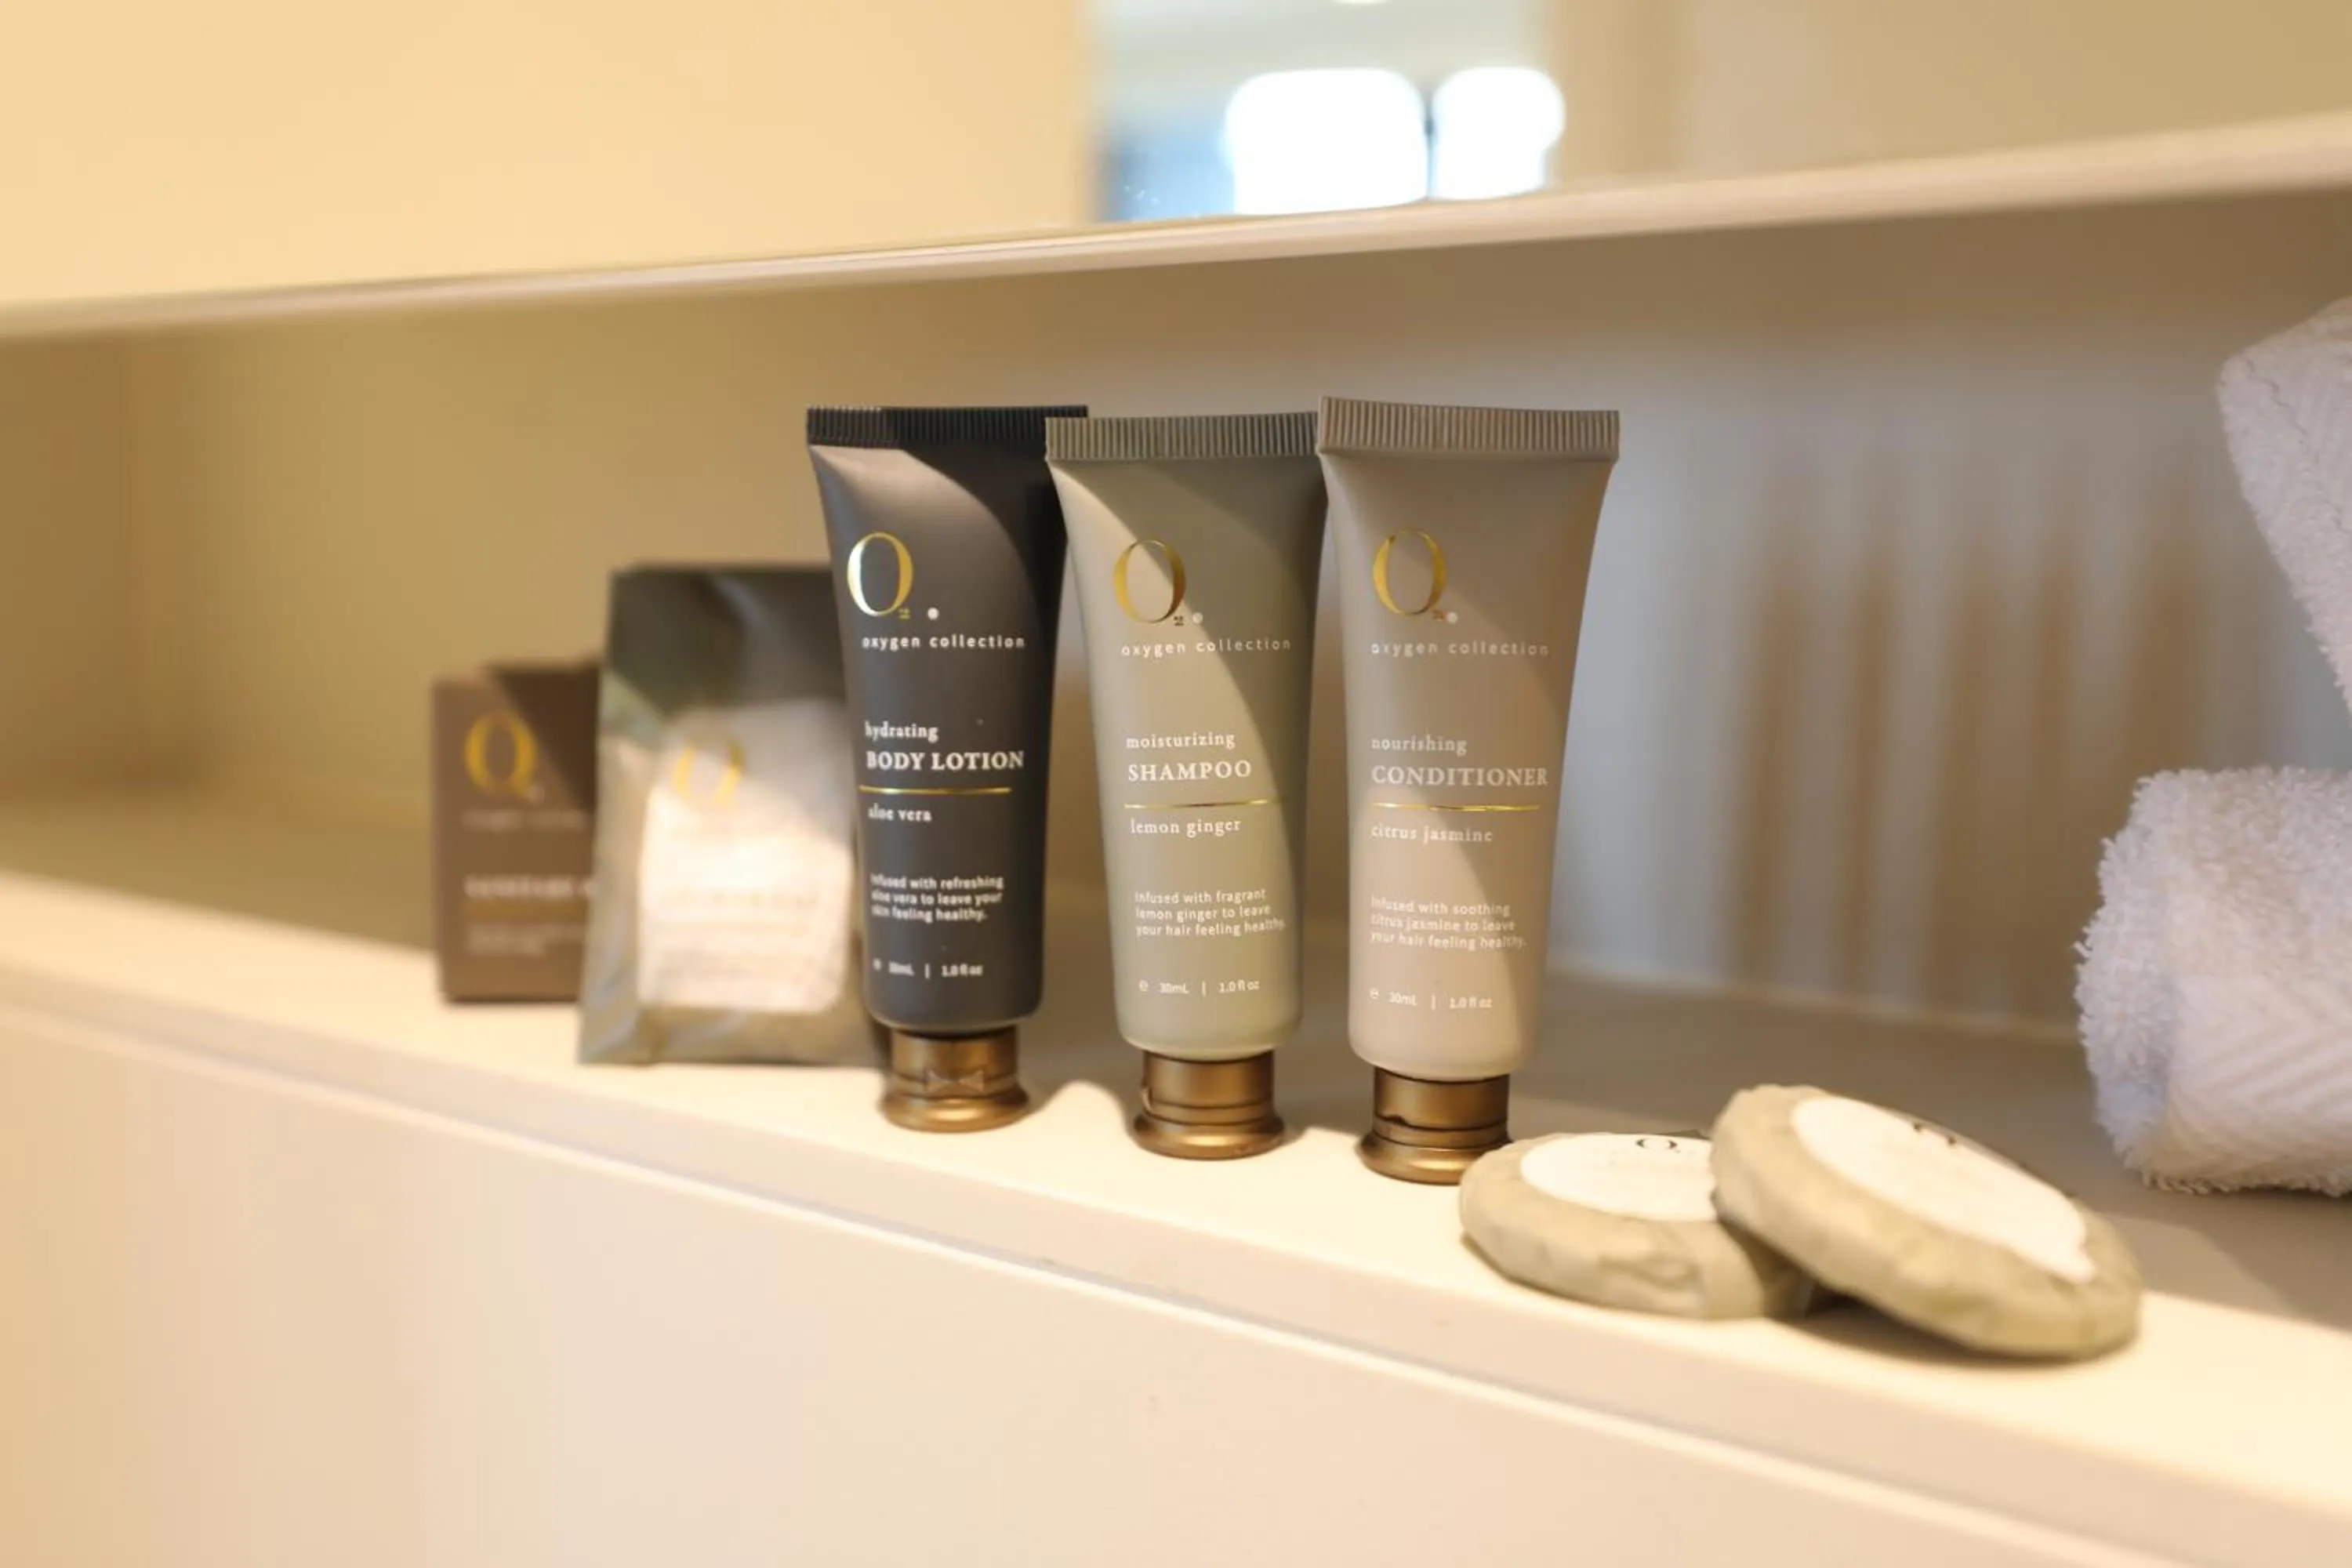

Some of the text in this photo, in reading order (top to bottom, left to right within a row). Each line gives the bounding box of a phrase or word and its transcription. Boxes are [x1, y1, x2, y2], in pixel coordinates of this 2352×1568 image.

[862, 633, 1025, 652] oxygen collection
[1121, 637, 1291, 659] oxygen collection
[1371, 640, 1549, 658] oxygen collection
[865, 720, 939, 743] hydrating
[1126, 731, 1236, 750] moisturizing
[1371, 734, 1468, 757] nourishing
[866, 750, 1024, 770] BODY LOTION
[1128, 760, 1251, 782] SHAMPOO
[1372, 765, 1548, 786] CONDITIONER
[868, 802, 932, 822] aloe vera
[1131, 818, 1242, 838] lemon ginger
[1371, 823, 1494, 844] citrus jasmine
[909, 877, 937, 890] with
[940, 875, 1004, 890] refreshing
[920, 893, 935, 905] to
[937, 892, 972, 906] leave
[1183, 891, 1211, 903] with
[1216, 888, 1266, 905] fragrant
[1136, 905, 1271, 923] lemon ginger to leave
[1418, 902, 1448, 915] with
[1453, 902, 1511, 917] soothing
[1137, 924, 1161, 937] your
[1165, 924, 1191, 936] hair
[1196, 923, 1241, 937] feeling
[1405, 916, 1461, 931] jasmine
[1465, 920, 1479, 931] to
[1483, 918, 1515, 931] leave
[1399, 931, 1423, 947] hair
[1428, 934, 1476, 951] feeling
